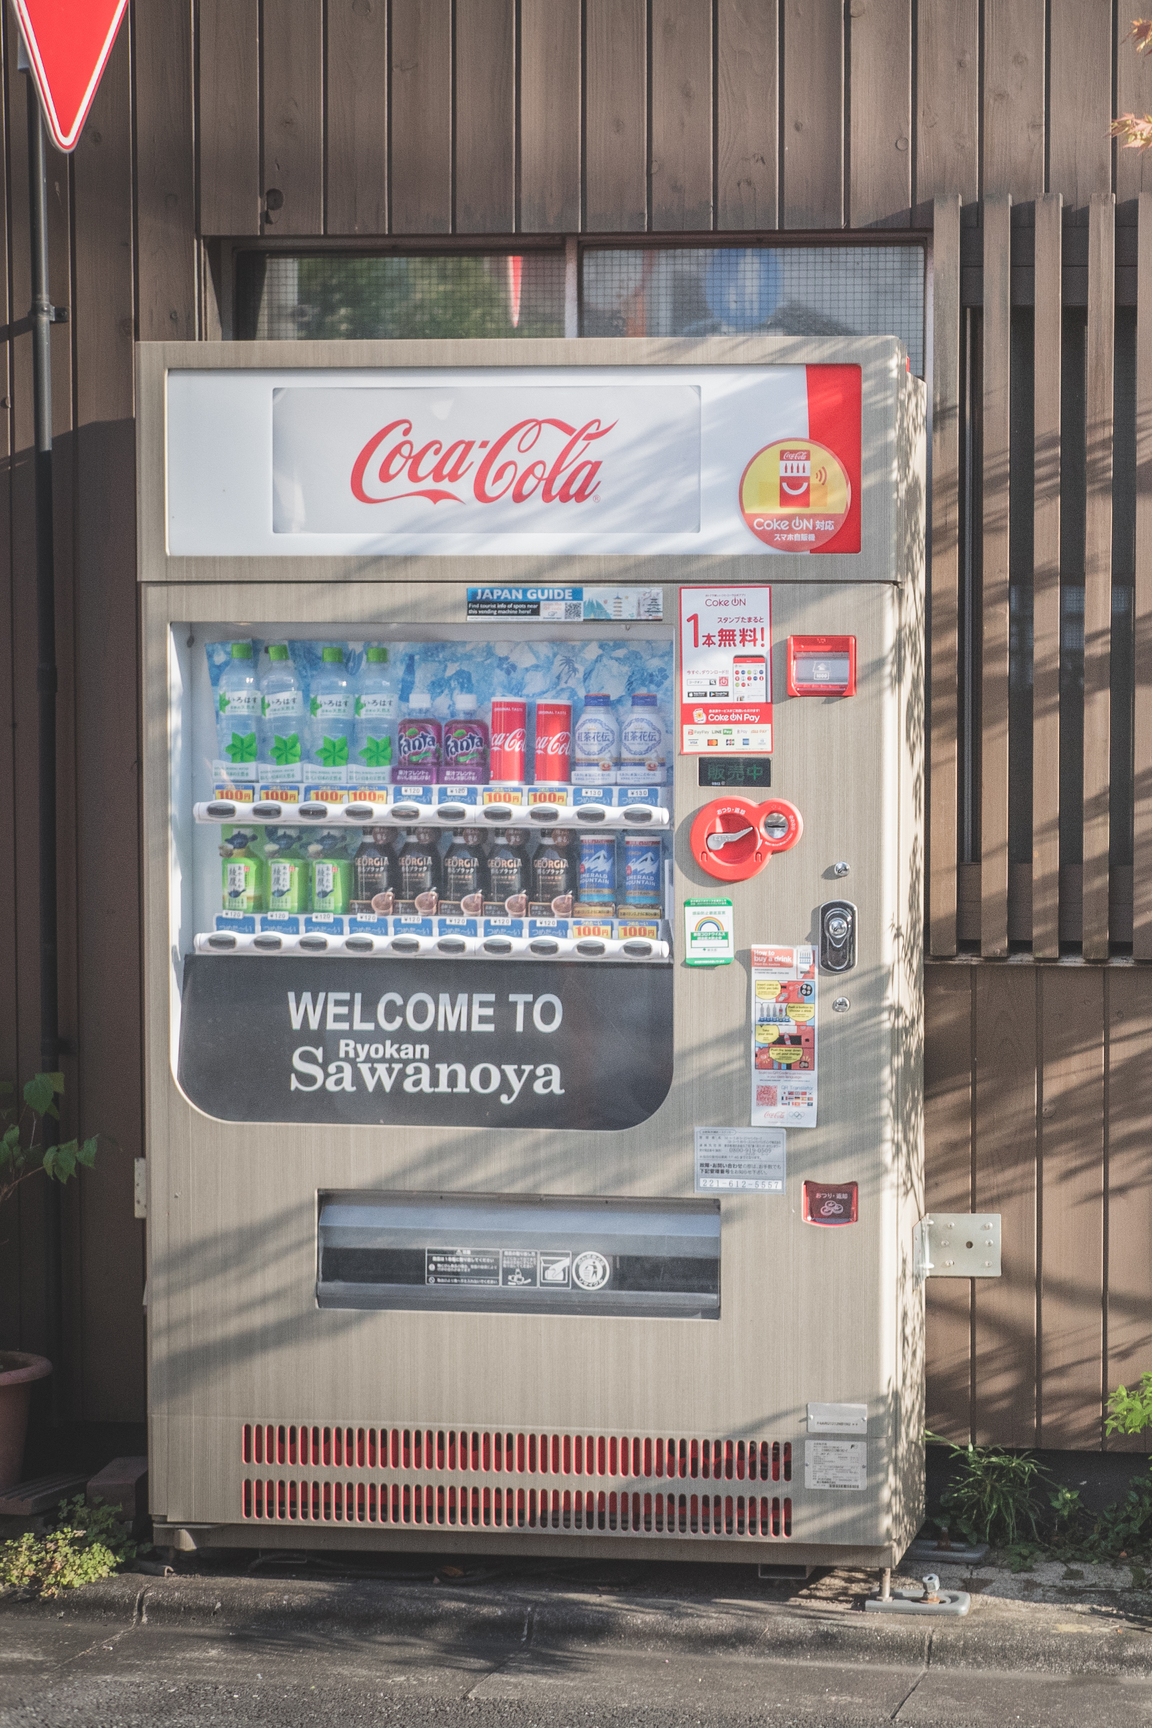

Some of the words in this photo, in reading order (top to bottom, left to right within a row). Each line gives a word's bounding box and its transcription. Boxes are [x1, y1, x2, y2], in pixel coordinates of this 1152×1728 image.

[350, 418, 619, 505] Coca-Cola
[754, 518, 789, 530] Coke
[792, 516, 813, 530] ON
[815, 520, 834, 530] 対応
[476, 589, 523, 600] JAPAN
[527, 589, 573, 600] GUIDE
[705, 599, 729, 607] Coke
[731, 597, 746, 607] ON
[744, 714, 760, 723] Pay
[577, 731, 610, 742] 紅茶花伝
[624, 731, 656, 742] 紅茶花伝
[399, 731, 436, 758] Fanta
[445, 732, 484, 759] Fanta
[707, 764, 762, 780] 販売中
[218, 790, 251, 800] 100円
[264, 790, 296, 801] 100円
[351, 791, 384, 802] 100円
[486, 792, 519, 803] 100円
[531, 792, 564, 803] 100円
[576, 927, 608, 936] 100円
[621, 927, 655, 937] 100円
[288, 991, 496, 1032] WELCOME
[508, 993, 563, 1033] TO
[339, 1039, 430, 1062] Ryokan
[290, 1046, 565, 1104] Sawanoya
[702, 1180, 779, 1188] 221-612-5557
